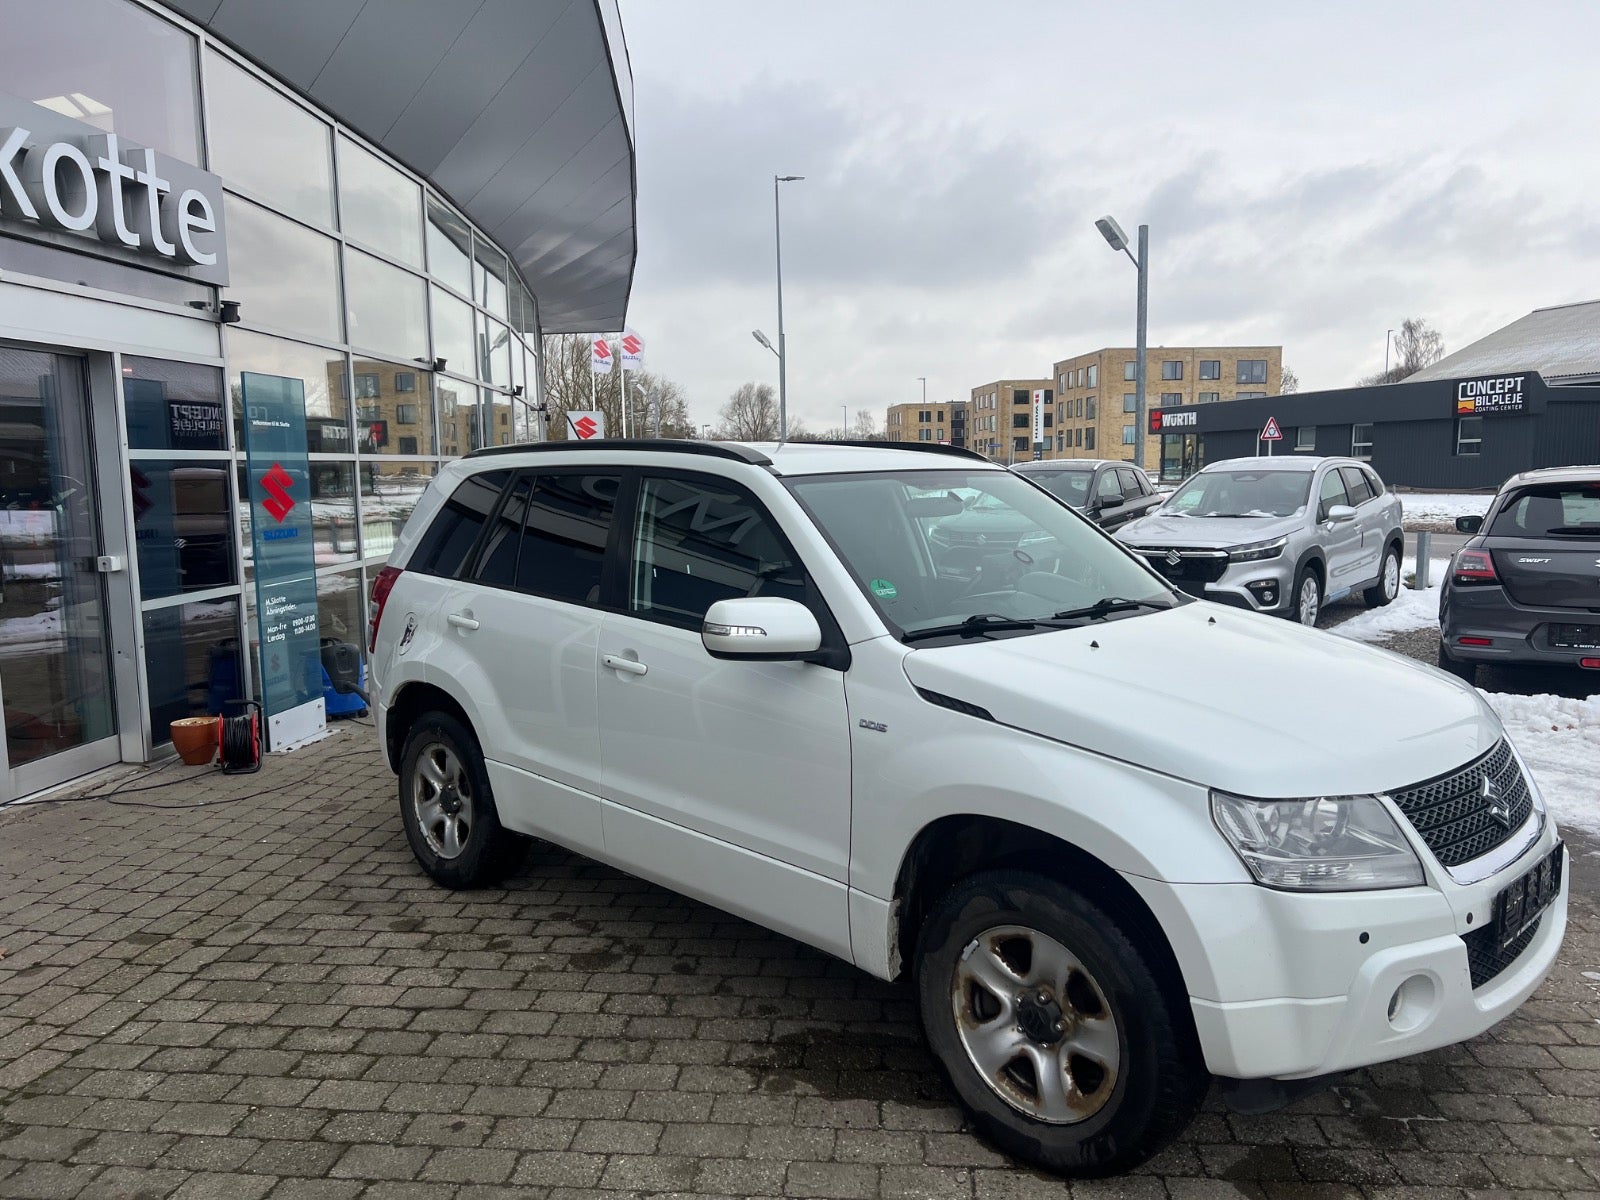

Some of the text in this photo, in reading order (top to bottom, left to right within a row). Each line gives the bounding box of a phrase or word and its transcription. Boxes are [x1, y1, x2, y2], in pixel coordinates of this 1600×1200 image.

[1458, 376, 1525, 401] CONCEPT
[1475, 392, 1524, 406] BILPLEJE
[1475, 405, 1499, 413] COATING
[1162, 411, 1197, 427] WÜRTH
[263, 527, 298, 541] SUZUKI
